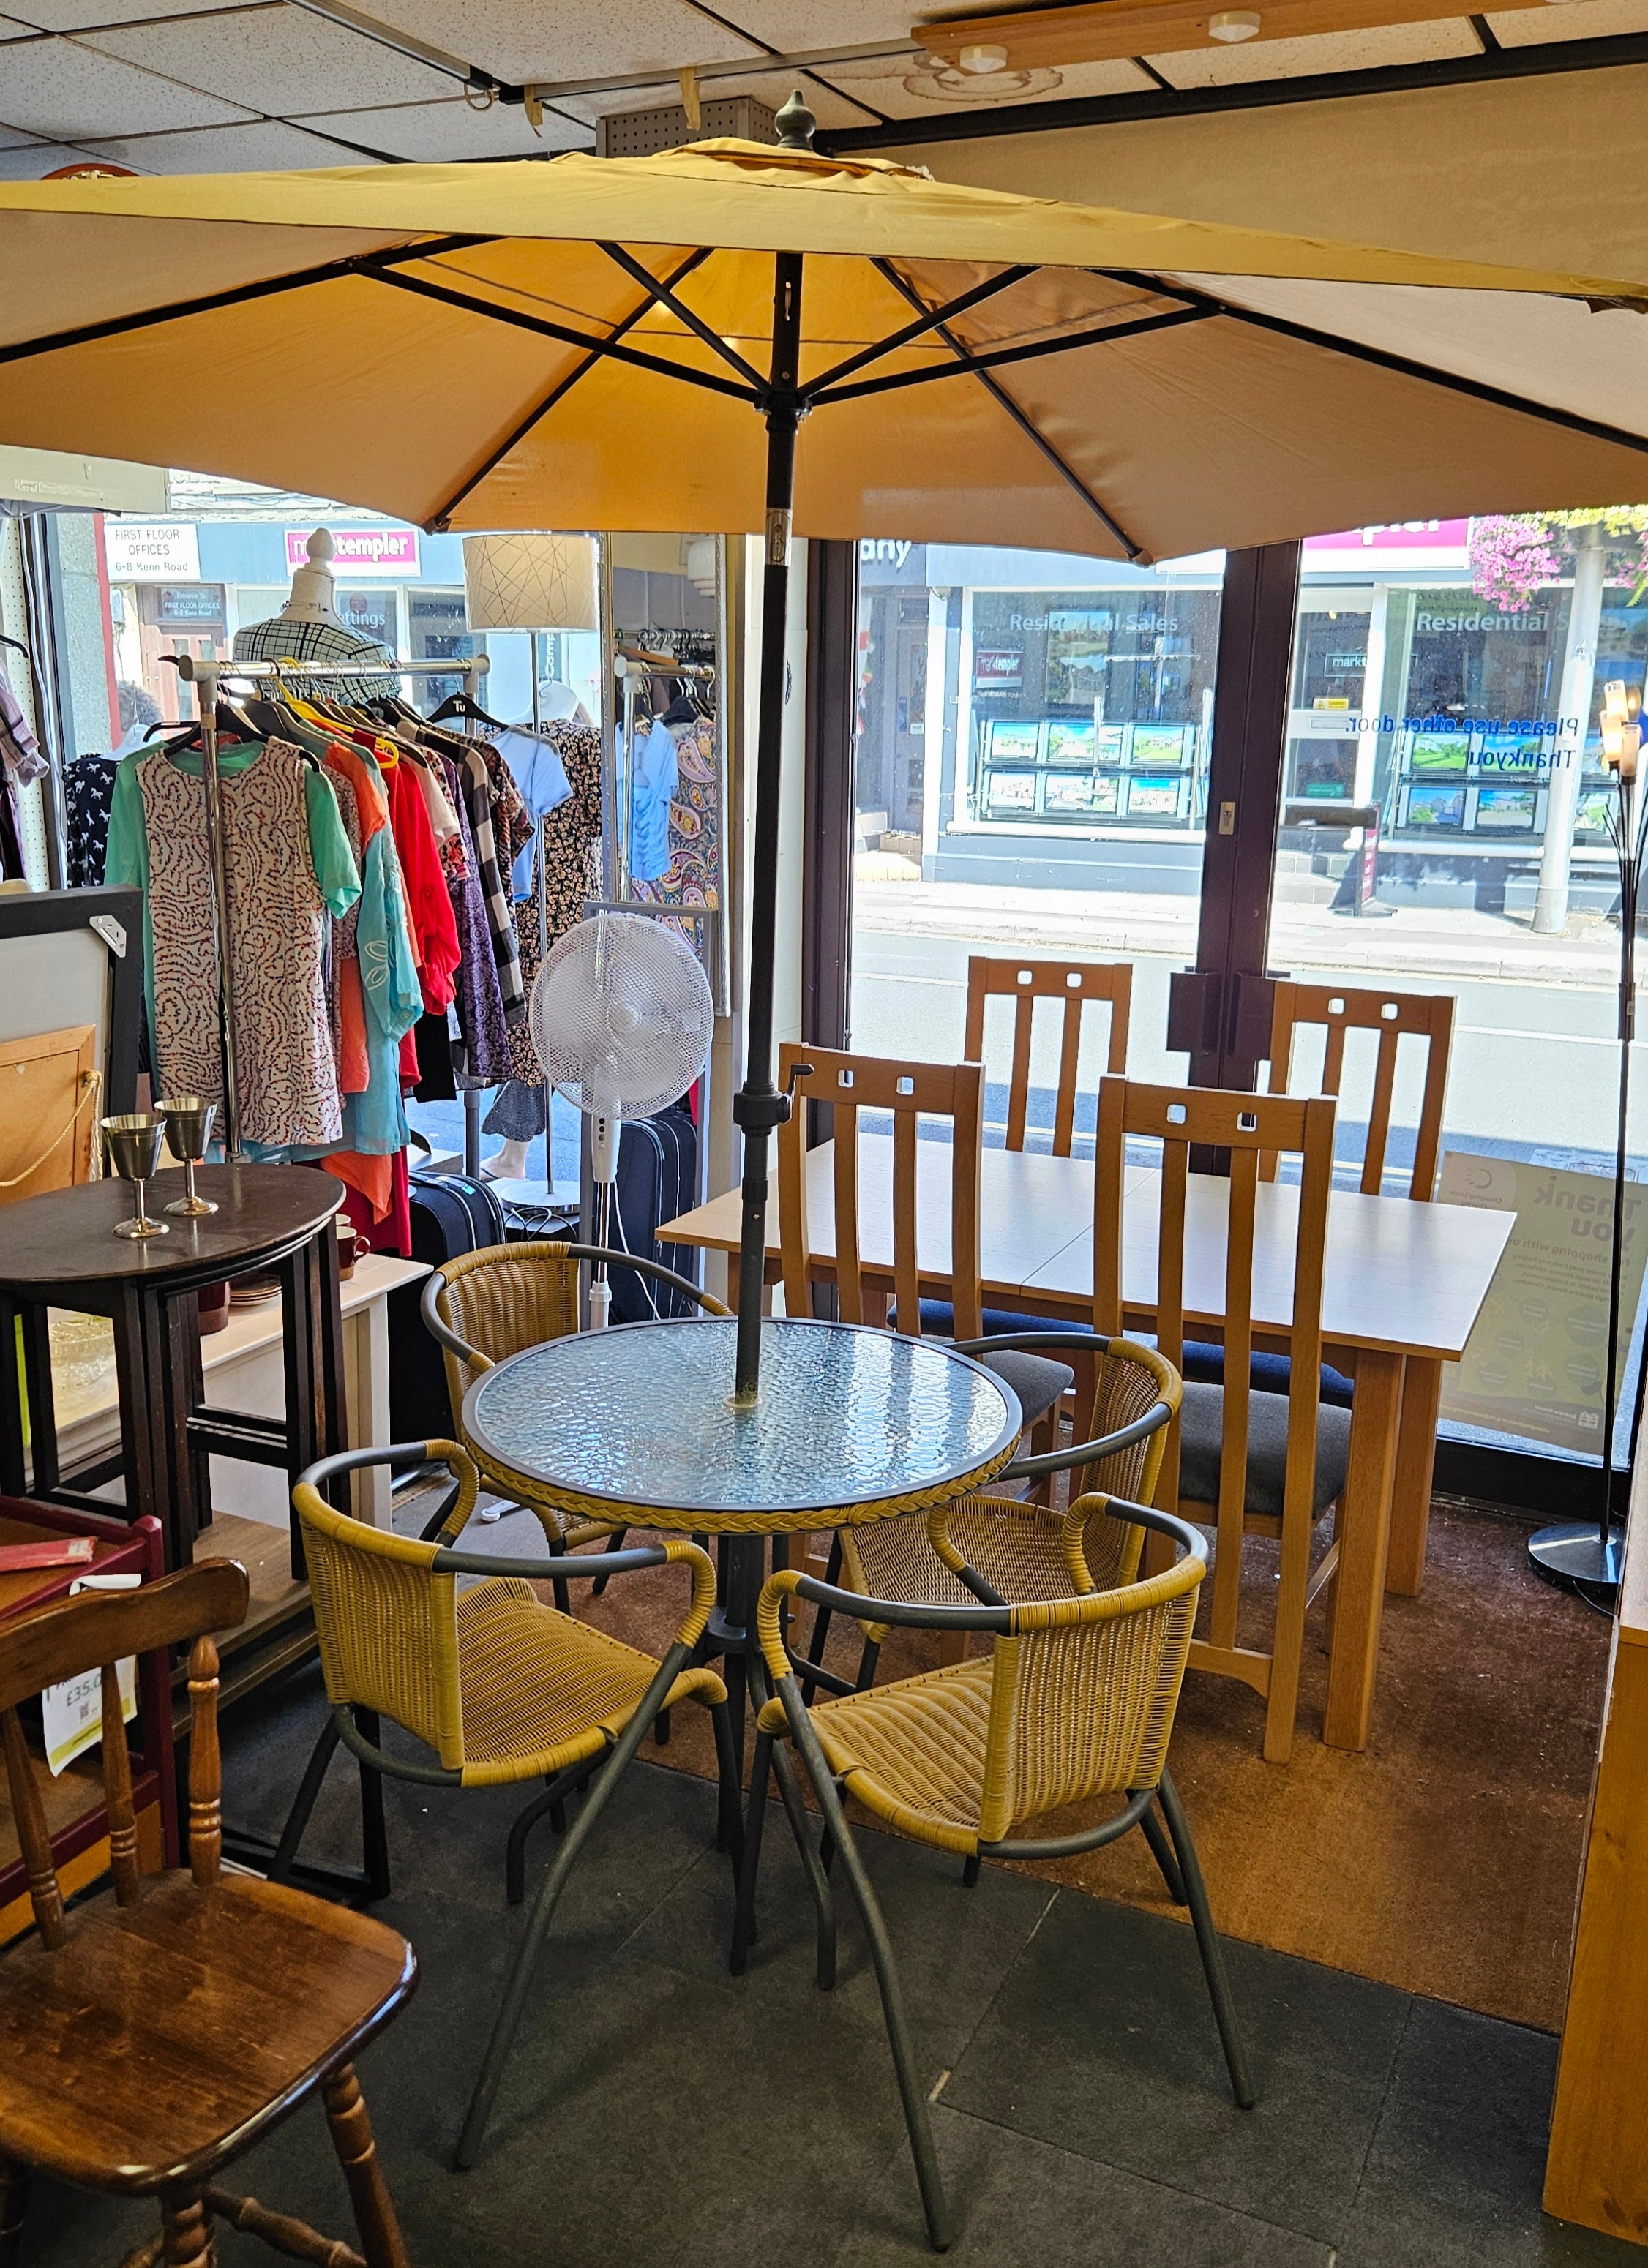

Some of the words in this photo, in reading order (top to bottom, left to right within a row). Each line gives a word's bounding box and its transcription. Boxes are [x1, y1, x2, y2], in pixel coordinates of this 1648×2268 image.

[115, 530, 141, 540] FIRST
[146, 529, 180, 540] FLOOR
[128, 544, 170, 555] OFFICES
[293, 533, 409, 563] mtempler
[116, 563, 132, 571] 6-8
[137, 562, 160, 571] Kenn
[164, 562, 188, 571] Road
[339, 609, 386, 629] ettings
[1010, 614, 1119, 631] Residtial
[1126, 613, 1178, 631] Sales
[1416, 611, 1549, 631] Residential
[452, 700, 466, 712] Tu
